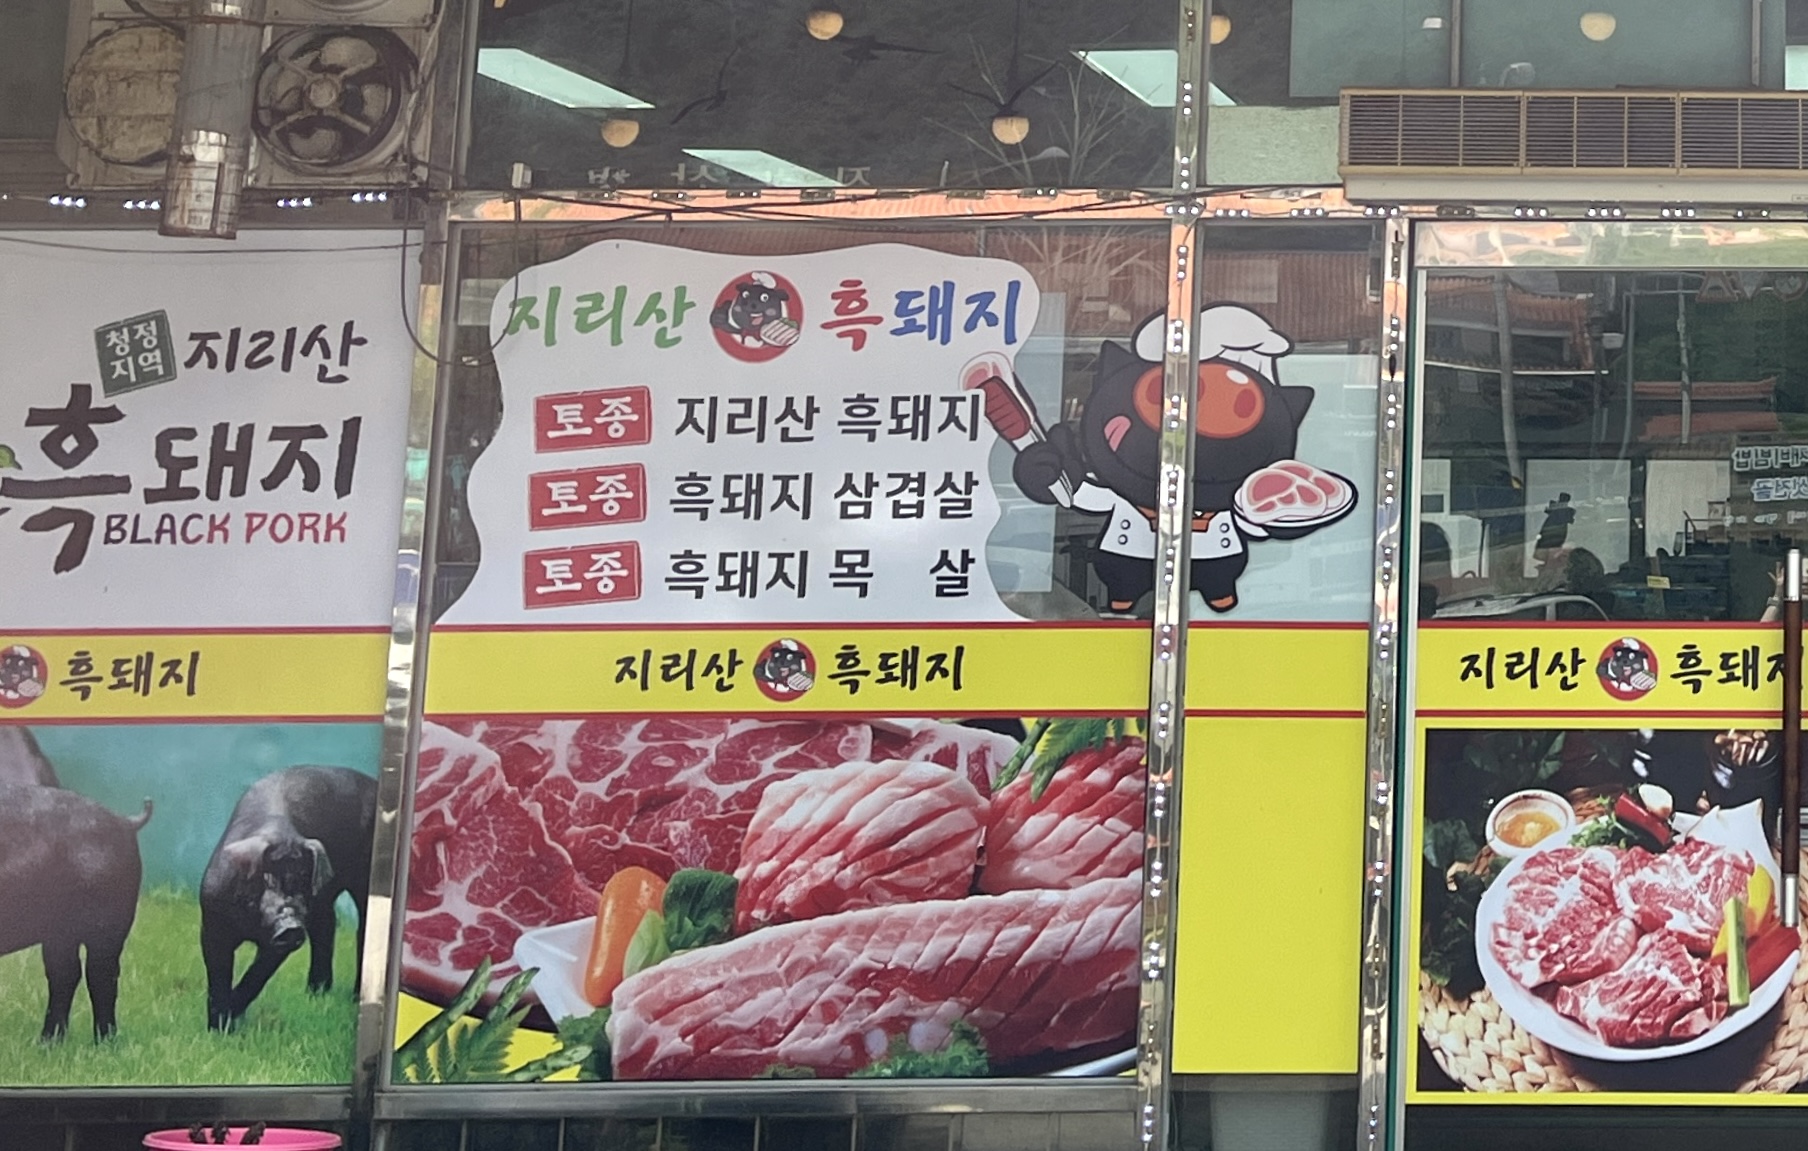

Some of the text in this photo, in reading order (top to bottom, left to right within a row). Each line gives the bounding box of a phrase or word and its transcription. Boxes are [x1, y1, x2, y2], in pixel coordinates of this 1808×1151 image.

[105, 319, 160, 356] 청정
[508, 278, 1021, 351] 지리산 흑돼지
[110, 351, 165, 383] 지역
[183, 320, 368, 384] 지리산
[546, 392, 981, 444] 토종 지리산 흑돼지
[0, 384, 362, 575] 흑돼지
[540, 470, 980, 521] 토종 흑돼지 삼겹살
[103, 511, 348, 545] BLACK PORK
[535, 548, 977, 599] 토종 흑돼지 목 살
[59, 650, 200, 701] 흑돼지
[615, 644, 965, 695] 지리산 흑돼지
[1460, 646, 1586, 692] 지리산
